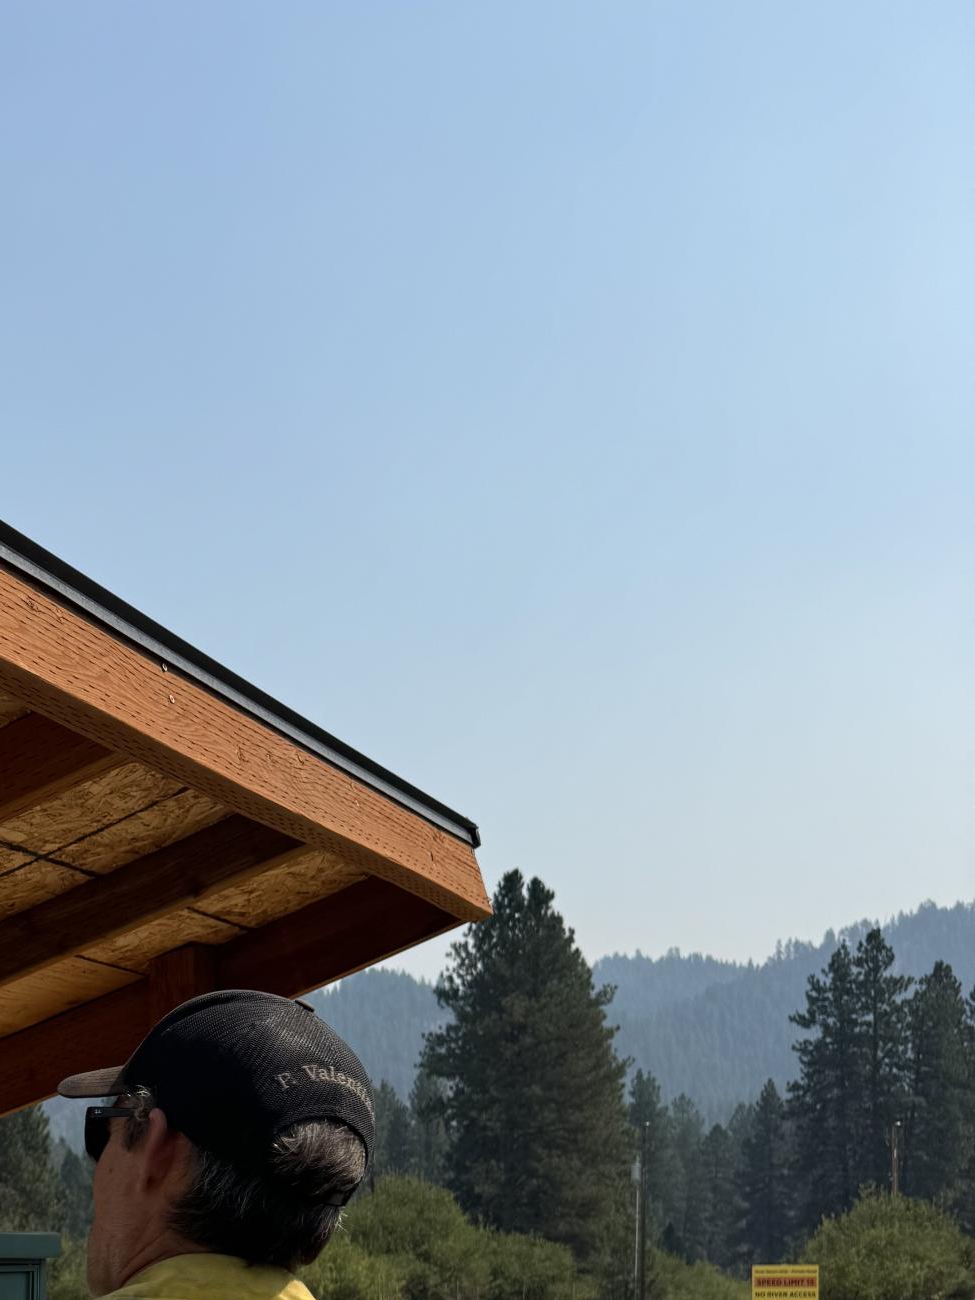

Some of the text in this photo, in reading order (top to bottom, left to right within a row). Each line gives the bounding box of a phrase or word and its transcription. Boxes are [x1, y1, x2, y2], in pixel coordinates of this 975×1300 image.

[275, 1071, 298, 1091] P.
[758, 1279, 782, 1287] SPEED
[783, 1279, 804, 1287] LIMIT
